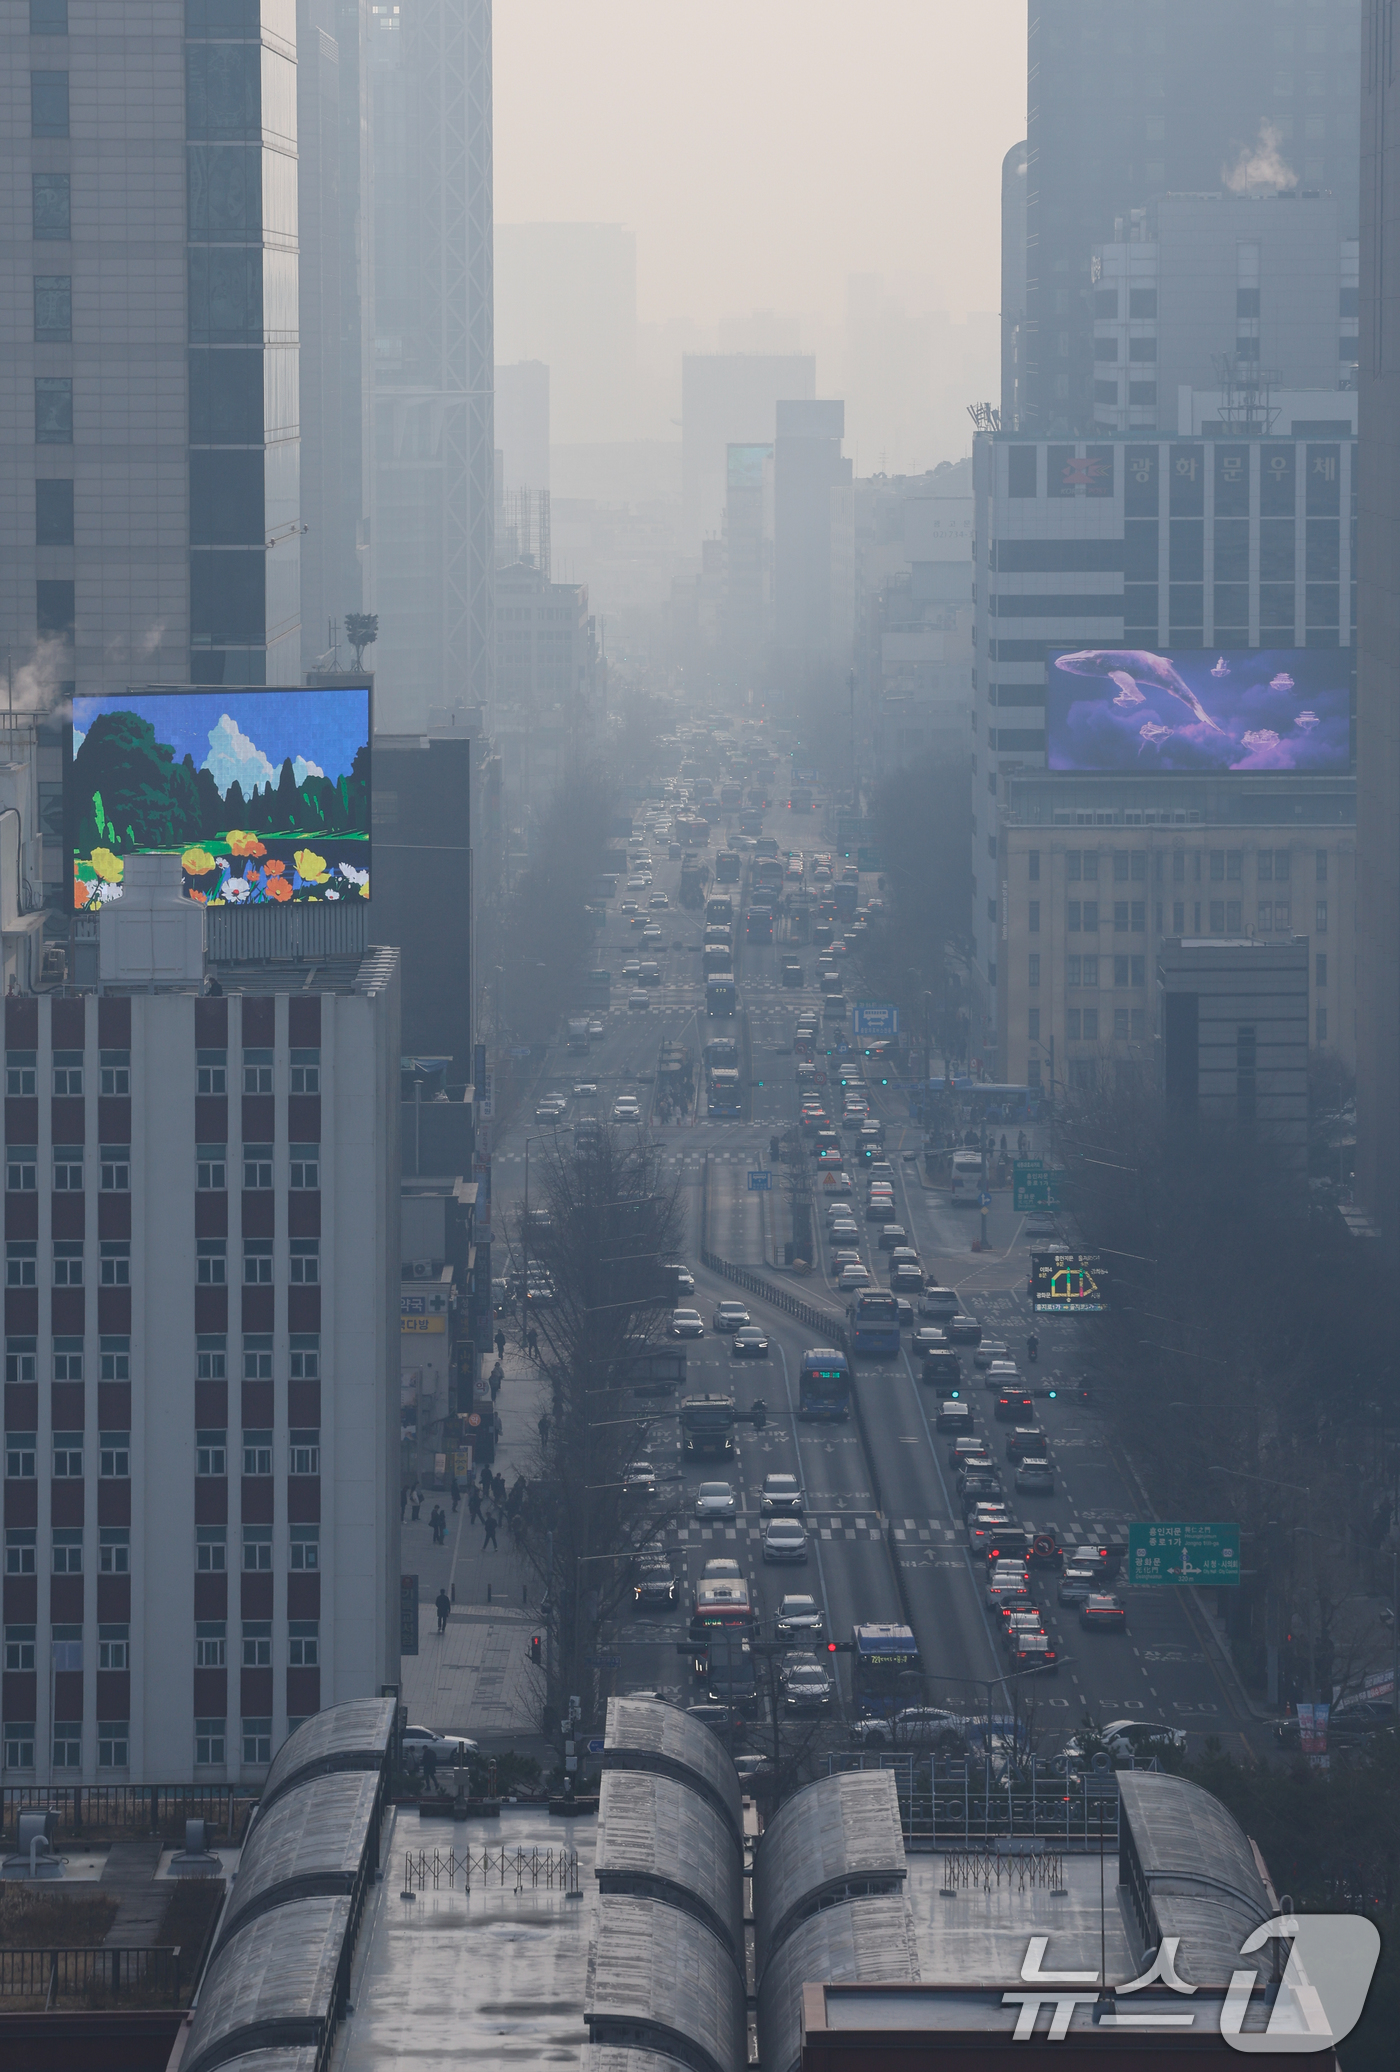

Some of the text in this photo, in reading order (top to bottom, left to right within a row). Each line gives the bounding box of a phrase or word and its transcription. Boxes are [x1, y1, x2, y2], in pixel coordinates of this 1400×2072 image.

[476, 1382, 486, 1392] 약
[1148, 1527, 1182, 1536] 흥인지문
[1148, 1538, 1182, 1546] 종로1가
[1135, 1557, 1161, 1567] 광화문
[1099, 1699, 1145, 1709] 50
[1172, 1702, 1219, 1711] 50
